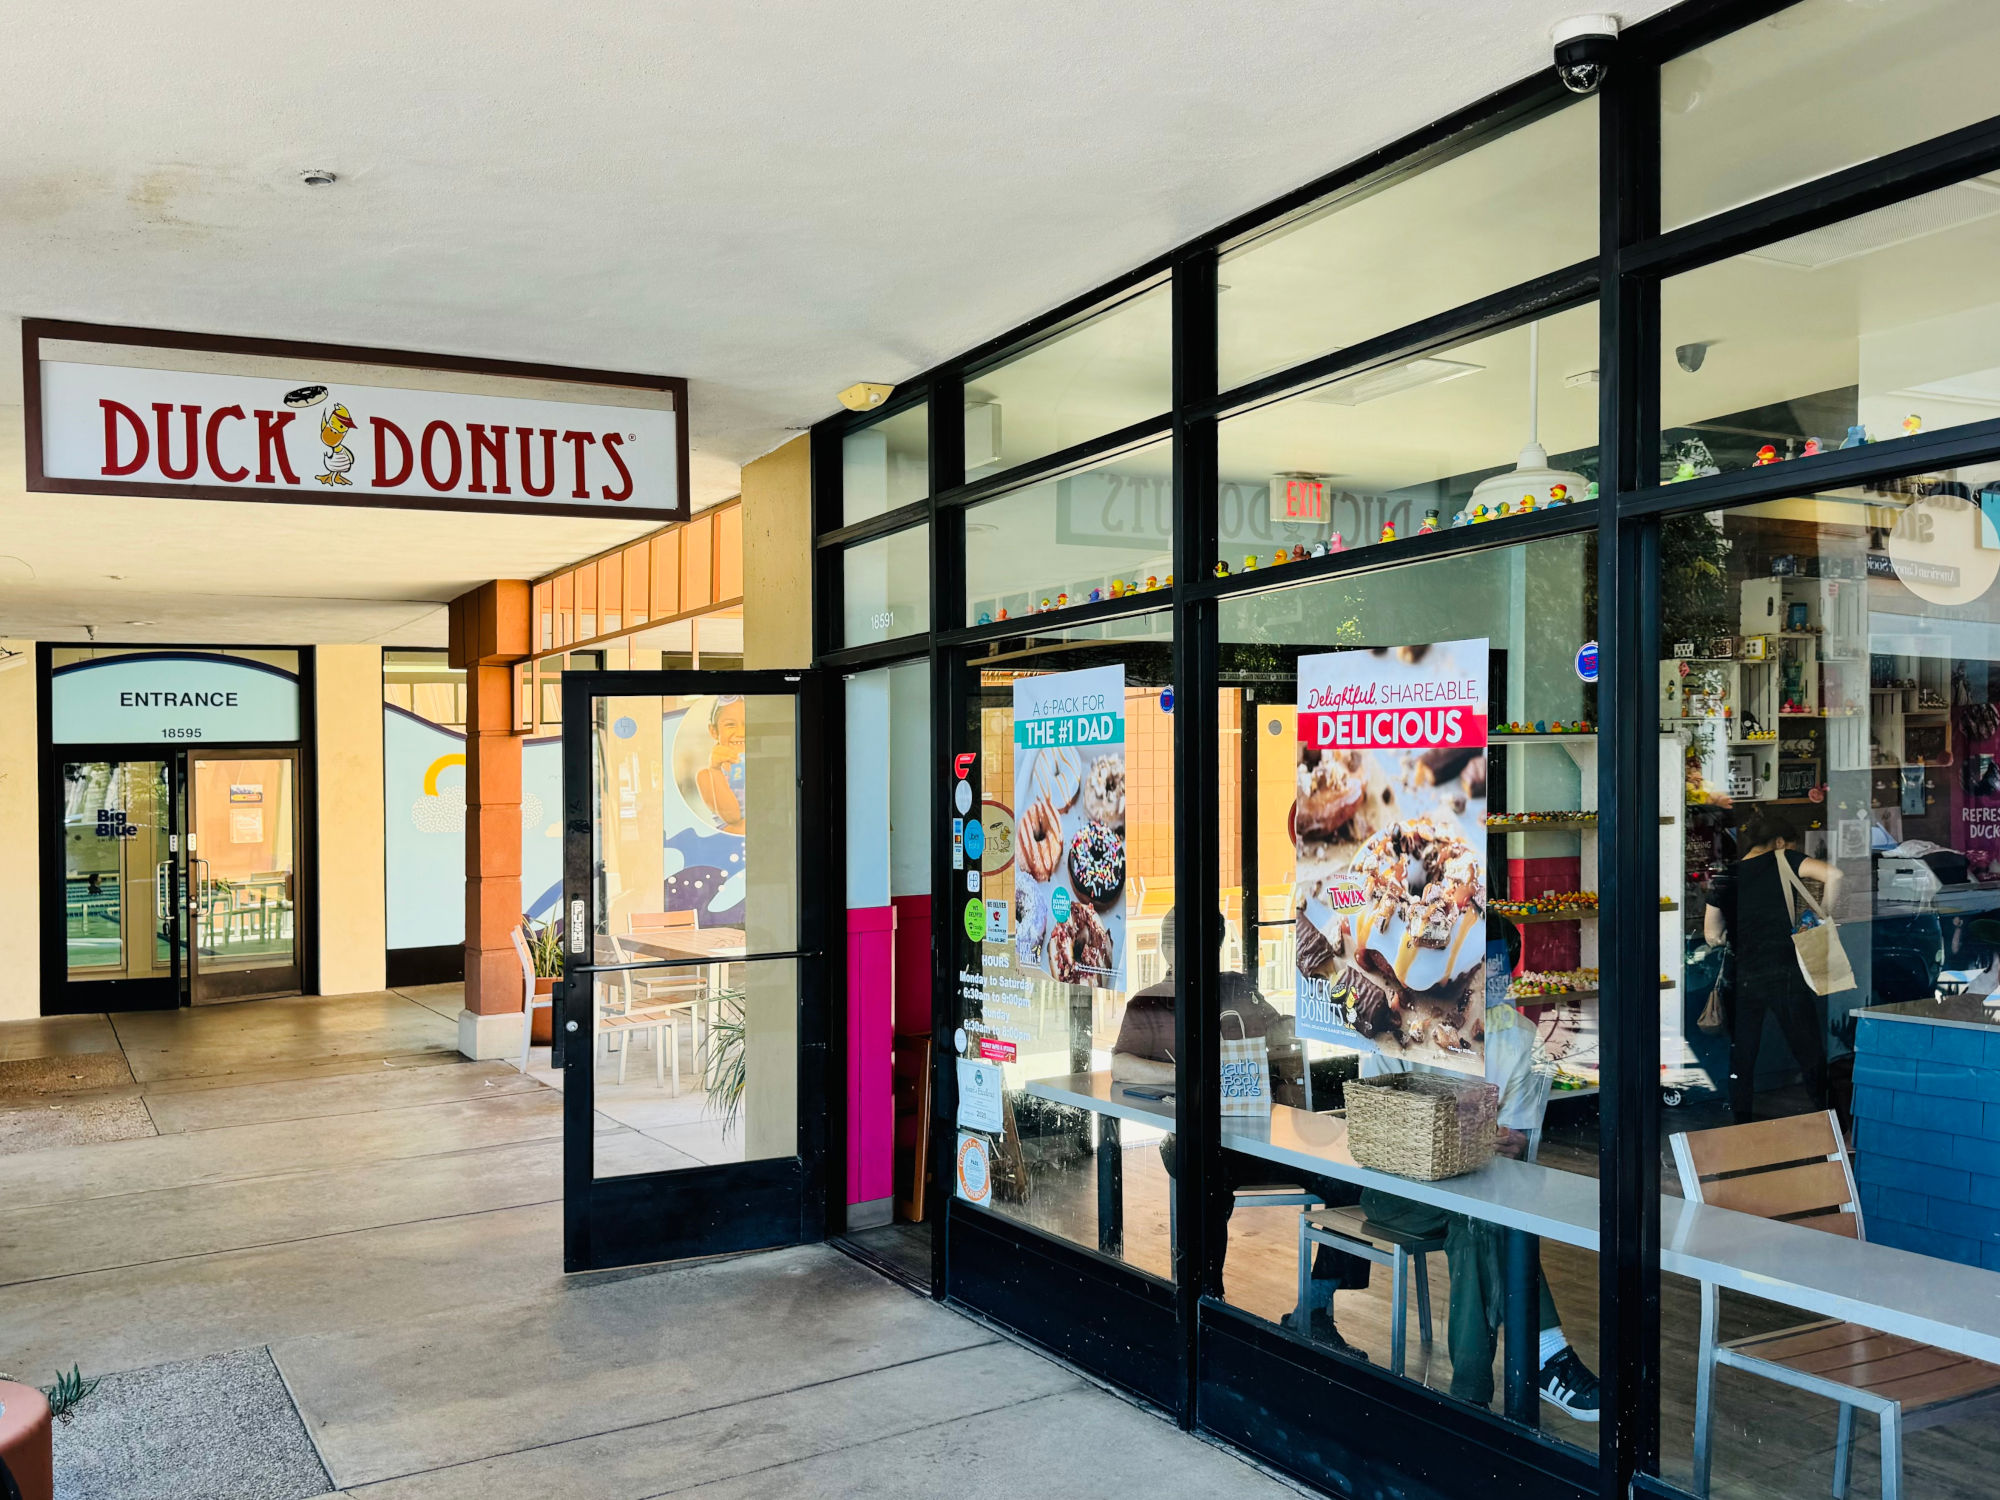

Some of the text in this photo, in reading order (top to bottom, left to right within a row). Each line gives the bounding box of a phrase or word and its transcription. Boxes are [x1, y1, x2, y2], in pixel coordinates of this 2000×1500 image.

[99, 398, 635, 502] DUCK DONUTS
[1286, 480, 1324, 520] EXIT
[870, 612, 895, 631] 18591
[120, 692, 238, 708] ENTRANCE
[1033, 694, 1105, 717] A 6-PACK FOR
[1307, 679, 1480, 713] Delightful, SHAREABLE,
[161, 728, 202, 739] 18595
[1026, 715, 1114, 745] THE #1 DAD
[1317, 711, 1463, 746] DELICIOUS
[98, 808, 127, 826] Big
[95, 824, 138, 837] Blue
[572, 904, 584, 942] PUSH
[981, 954, 1010, 969] HOURS
[960, 970, 1034, 994] Monday to Saturday
[1301, 976, 1332, 1003] DUCK
[963, 986, 1031, 1008] 6:30am to 9:00pm
[982, 1006, 1010, 1022] Sunday
[1301, 998, 1344, 1027] DONUTS
[963, 1019, 991, 1034] 6:30am
[992, 1025, 1000, 1035] to
[1223, 1075, 1260, 1087] Body
